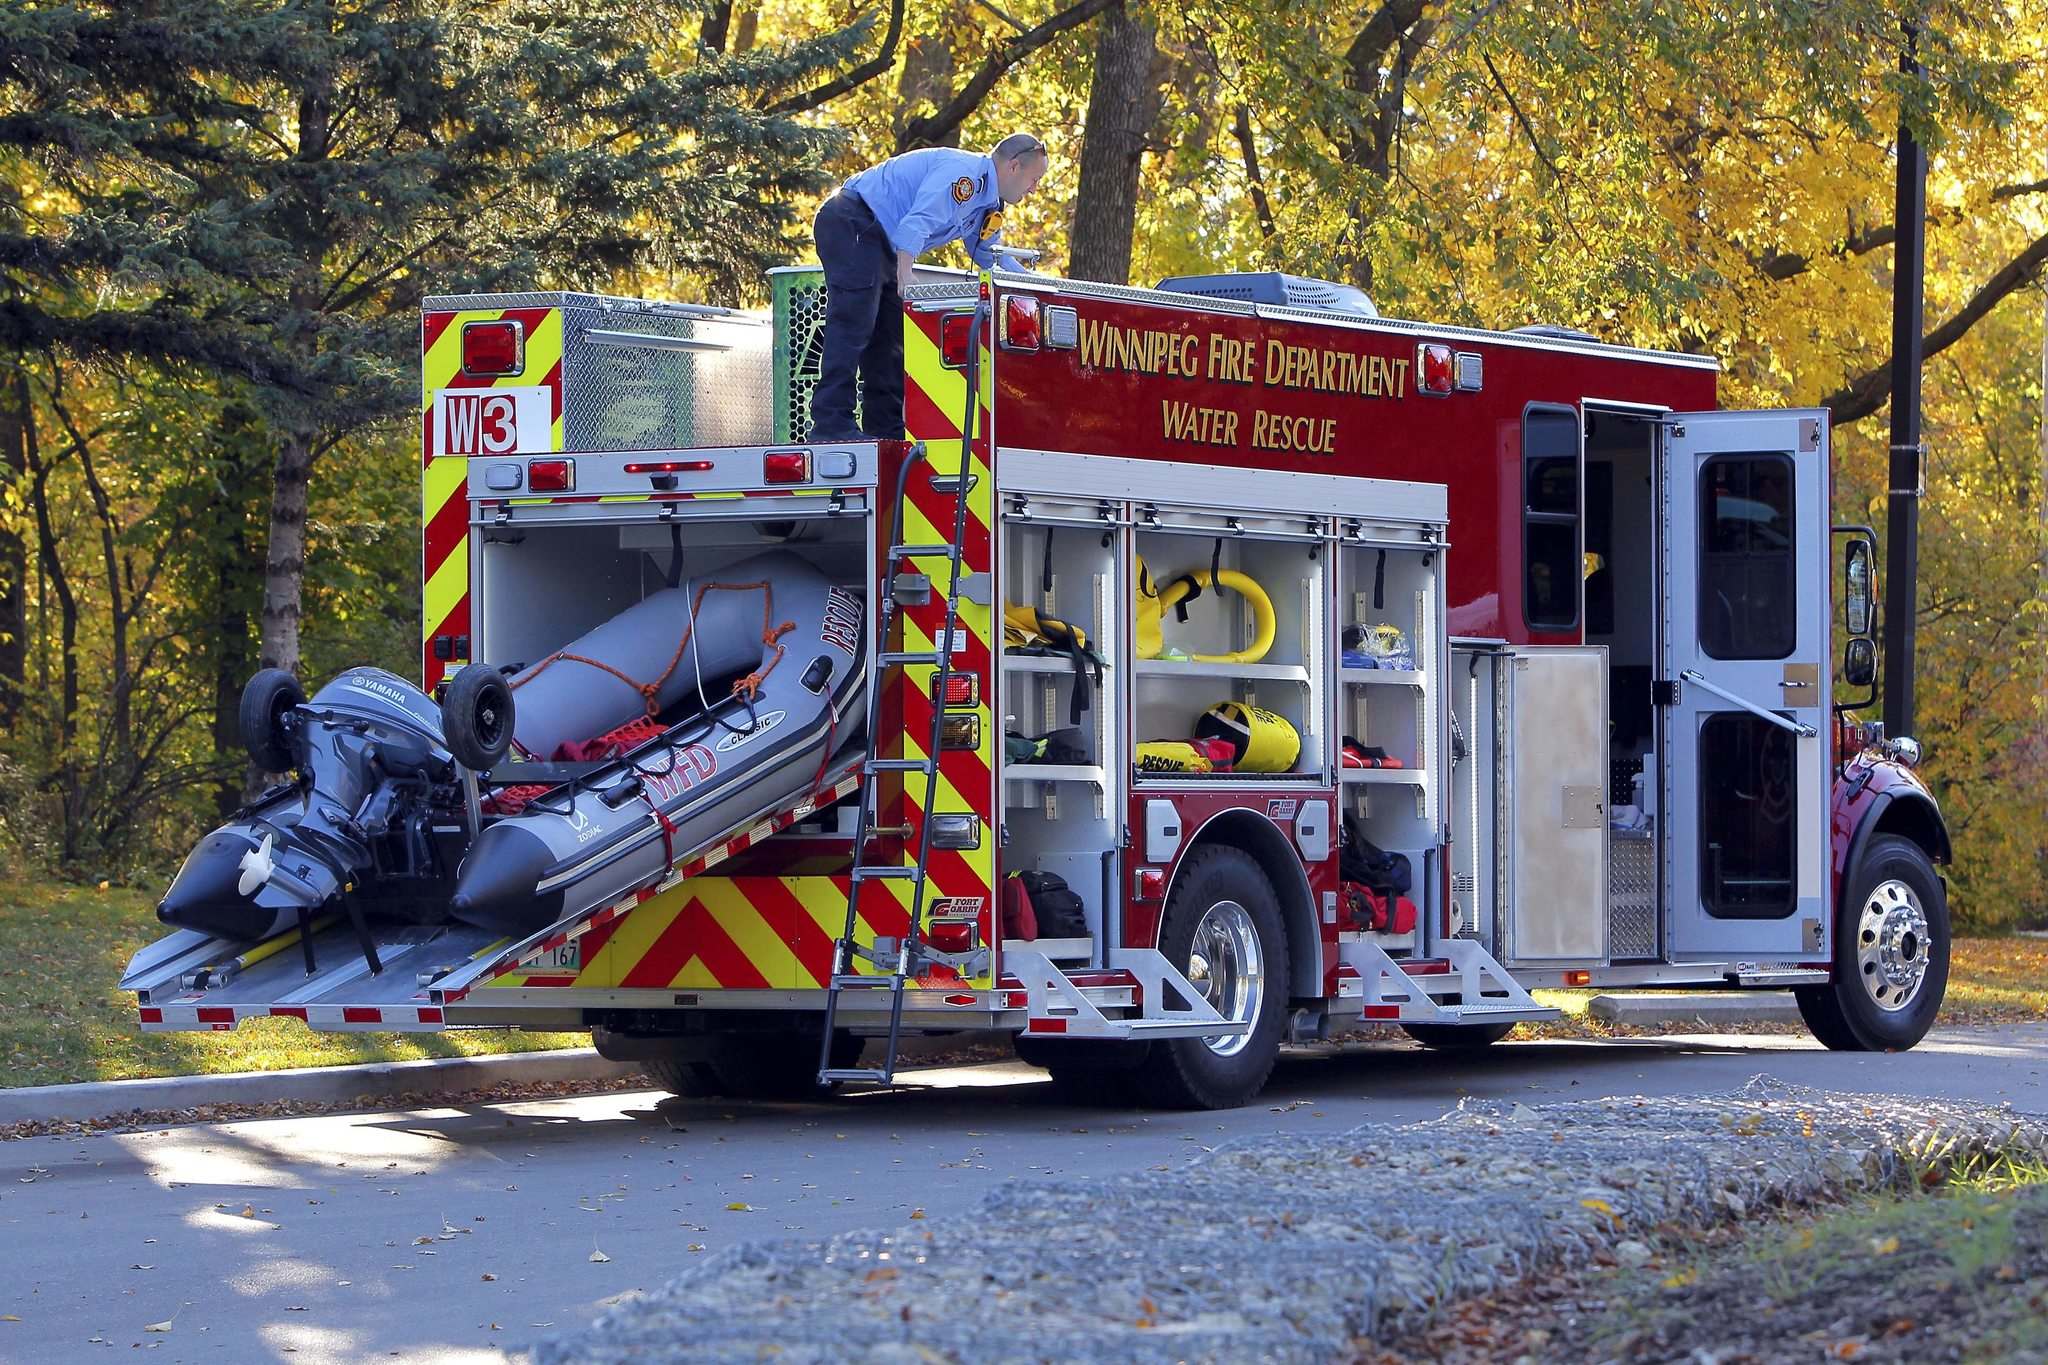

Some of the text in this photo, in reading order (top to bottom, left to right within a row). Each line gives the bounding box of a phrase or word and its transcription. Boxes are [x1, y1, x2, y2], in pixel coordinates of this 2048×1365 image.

[1078, 317, 1410, 399] WINNIPEG FIRE DEPARTMENT
[447, 395, 518, 454] W3
[1161, 399, 1337, 454] WATER RESCUE
[821, 585, 863, 658] RESCUE
[365, 679, 406, 704] YAMAHA
[638, 743, 718, 802] WFD
[955, 898, 979, 906] FORT
